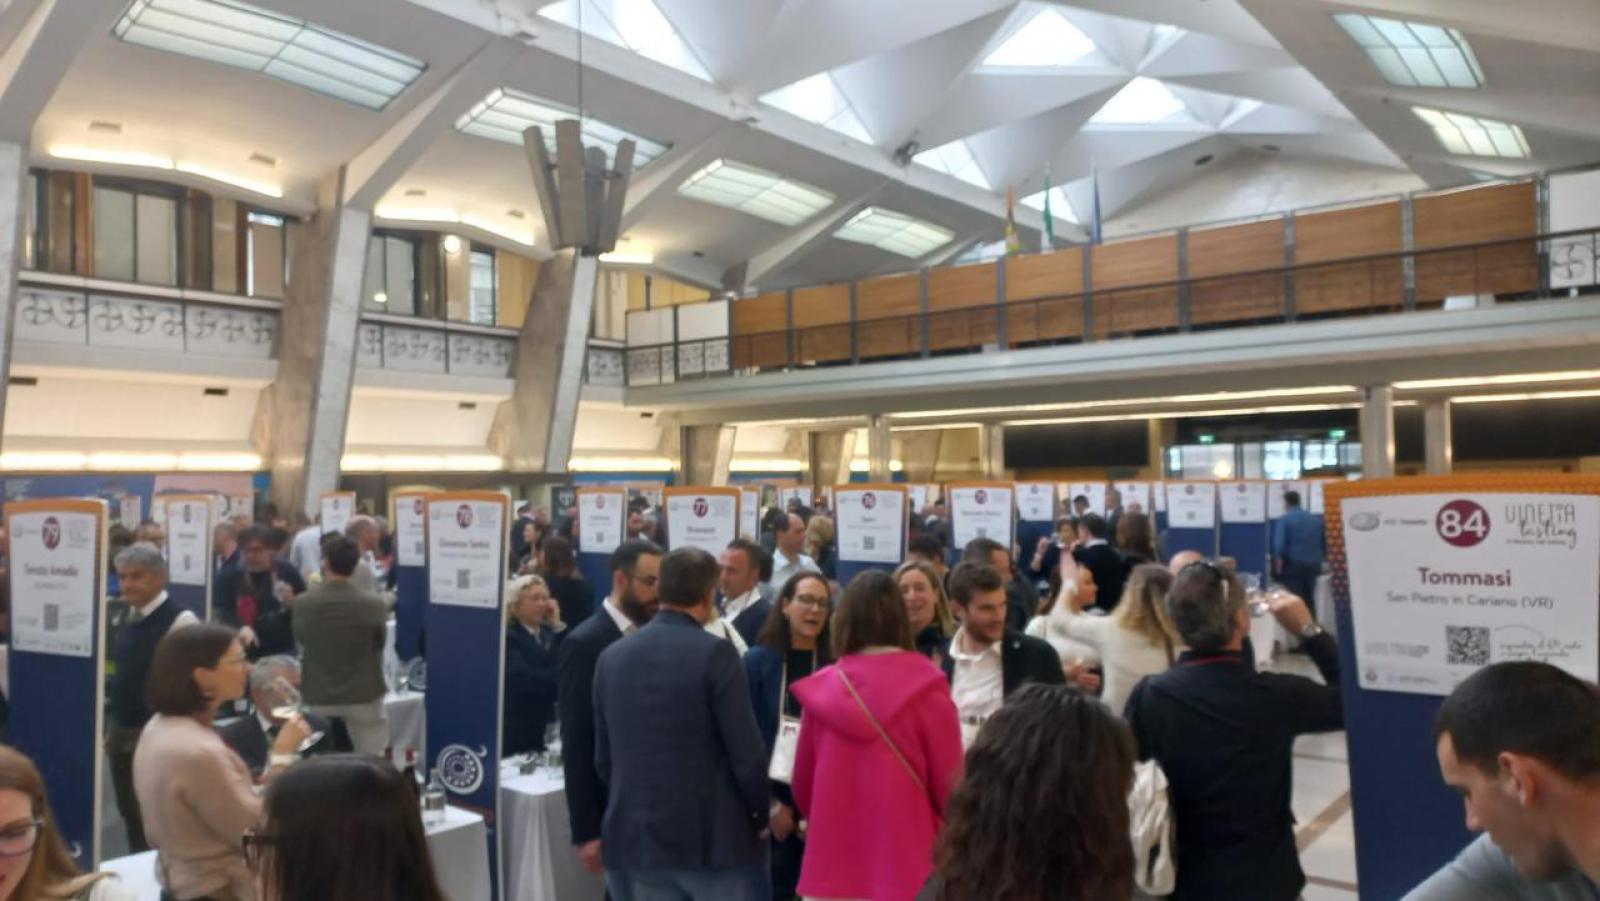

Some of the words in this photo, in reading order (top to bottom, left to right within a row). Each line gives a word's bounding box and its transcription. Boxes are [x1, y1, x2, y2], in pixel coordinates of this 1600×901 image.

[42, 523, 60, 542] 79
[1439, 510, 1487, 538] 84
[1417, 566, 1512, 587] Tommasi
[1386, 591, 1408, 603] San
[1411, 592, 1449, 605] Pietro
[1452, 594, 1464, 605] in
[1467, 595, 1517, 608] Cariano
[1521, 596, 1555, 610] (VR)
